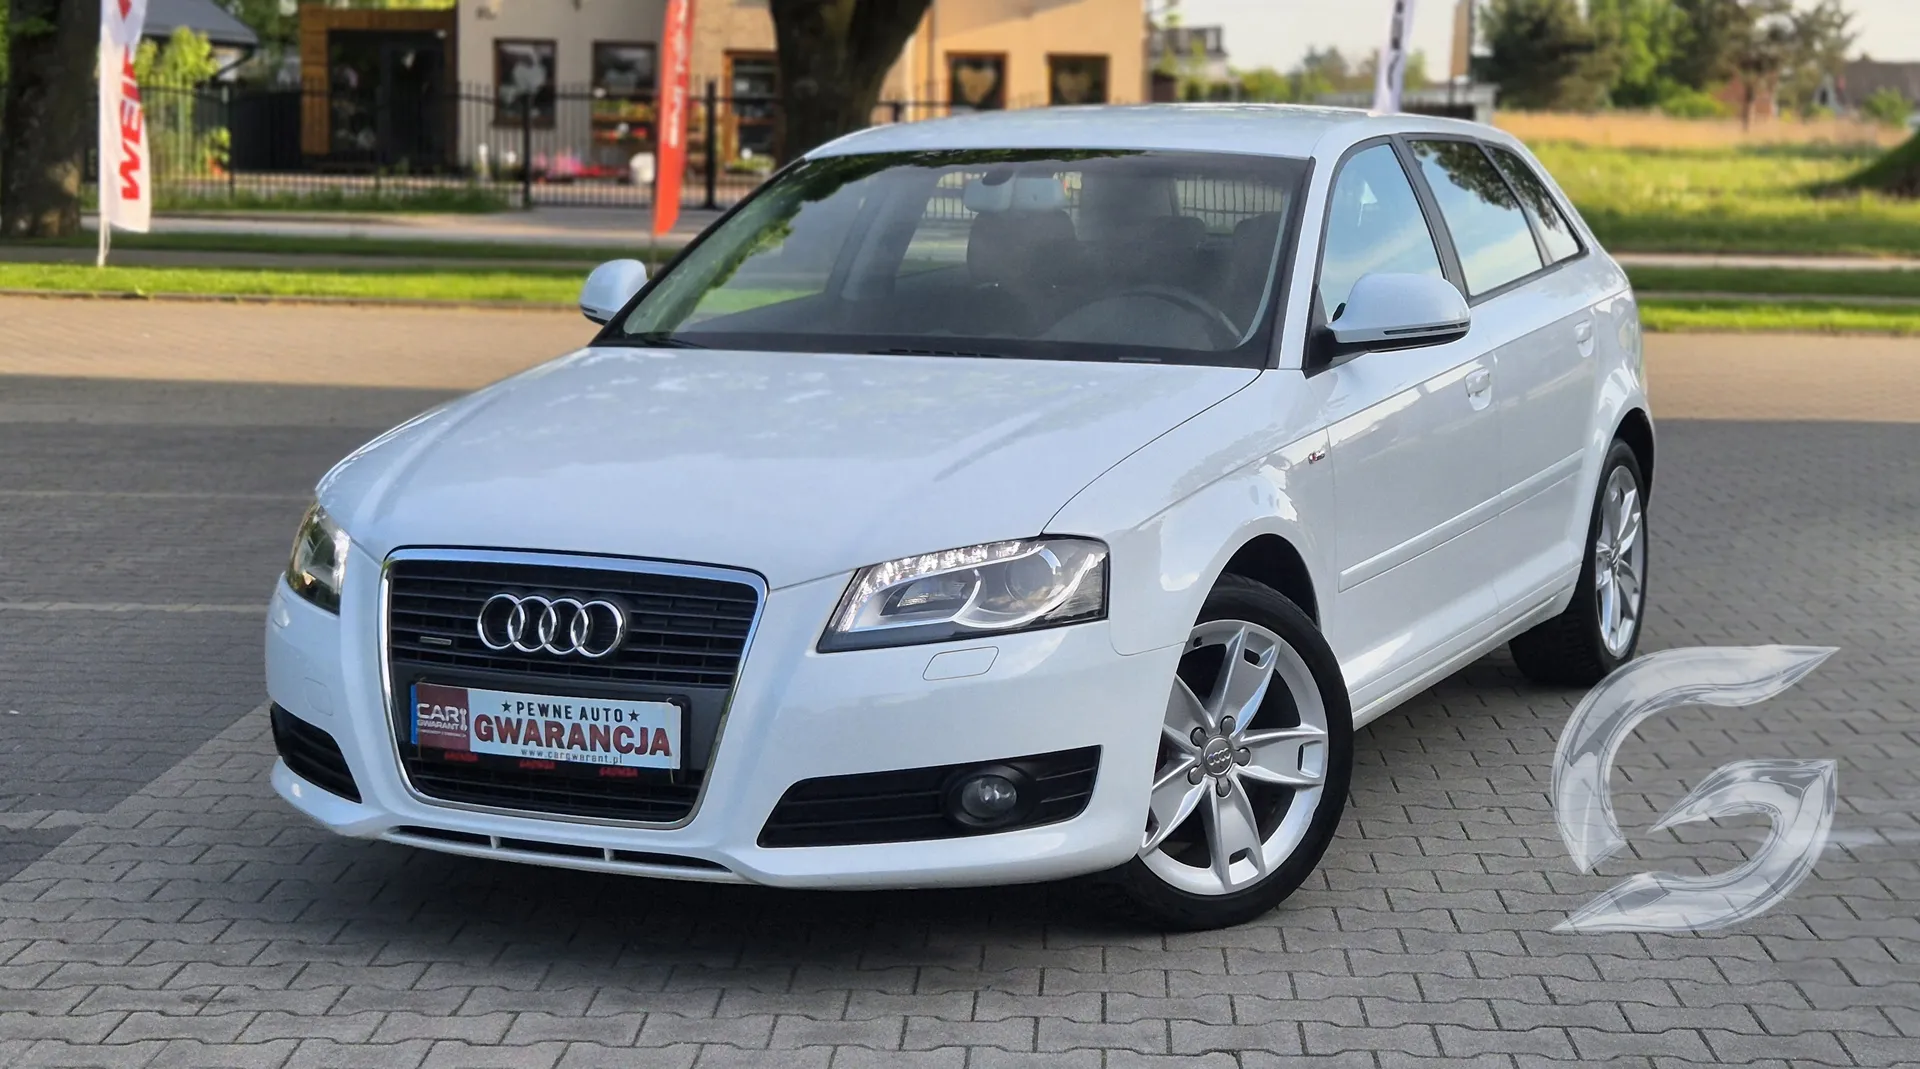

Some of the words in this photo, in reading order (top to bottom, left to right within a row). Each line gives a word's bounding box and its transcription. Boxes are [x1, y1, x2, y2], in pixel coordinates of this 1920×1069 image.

[516, 701, 573, 719] PEWNE
[580, 705, 623, 722] AUTO
[474, 714, 672, 756] GWARANCJA
[520, 749, 622, 765] www.cargwarant.pl
